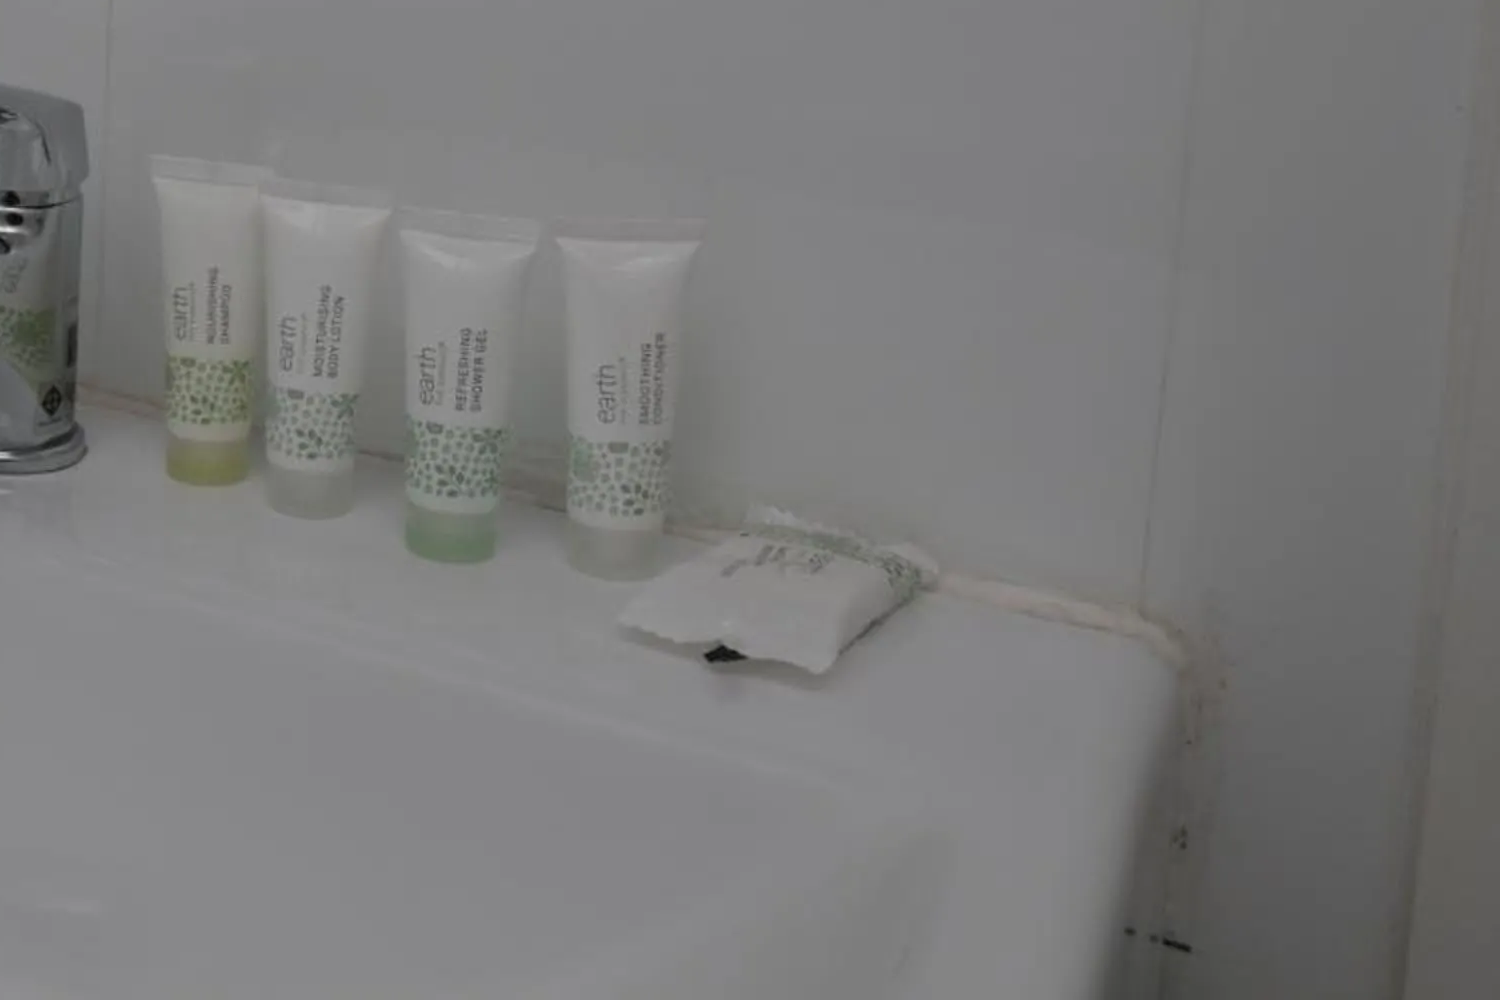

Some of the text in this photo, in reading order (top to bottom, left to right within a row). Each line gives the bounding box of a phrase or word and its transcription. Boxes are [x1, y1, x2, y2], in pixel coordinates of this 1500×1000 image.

[172, 286, 188, 342] earth
[219, 284, 232, 345] SHAMPOO
[277, 316, 298, 372] earth
[313, 285, 332, 378] MOISTURISING
[327, 296, 345, 379] BODY LOTION
[414, 347, 436, 406] earth
[455, 327, 472, 412] REFRESHING
[469, 328, 488, 413] SHOWER GEL
[594, 365, 616, 425] earth
[639, 343, 652, 425] SMOOTHING
[653, 332, 667, 425] CONDITIONER
